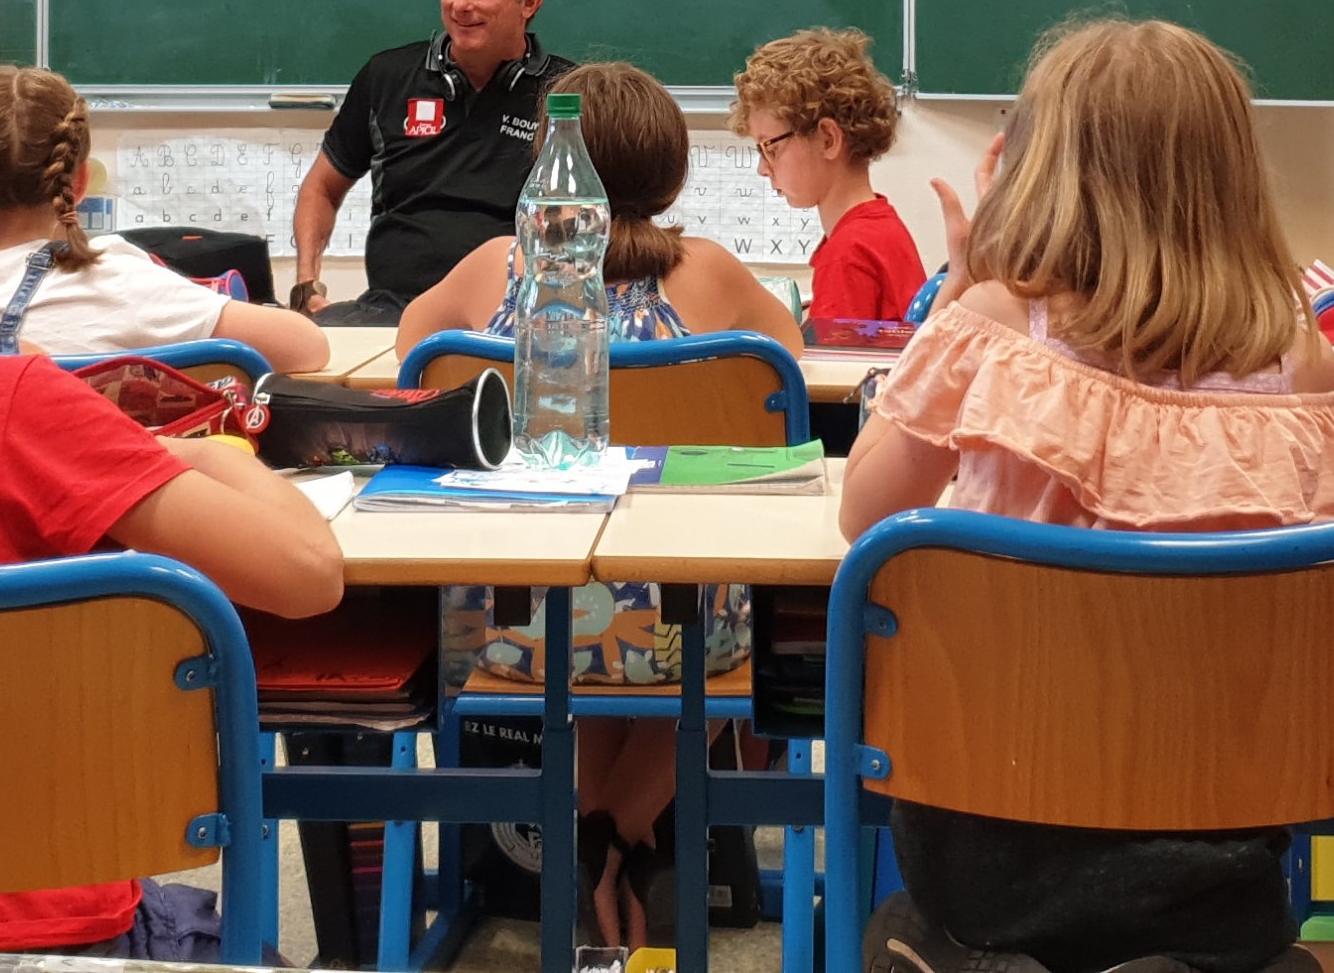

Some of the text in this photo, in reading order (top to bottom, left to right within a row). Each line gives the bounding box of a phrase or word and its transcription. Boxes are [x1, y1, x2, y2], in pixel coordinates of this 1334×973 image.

[502, 115, 539, 131] V. BOUY
[500, 125, 534, 141] FRANC
[734, 238, 811, 255] W X Y
[483, 723, 530, 744] LE REAL
